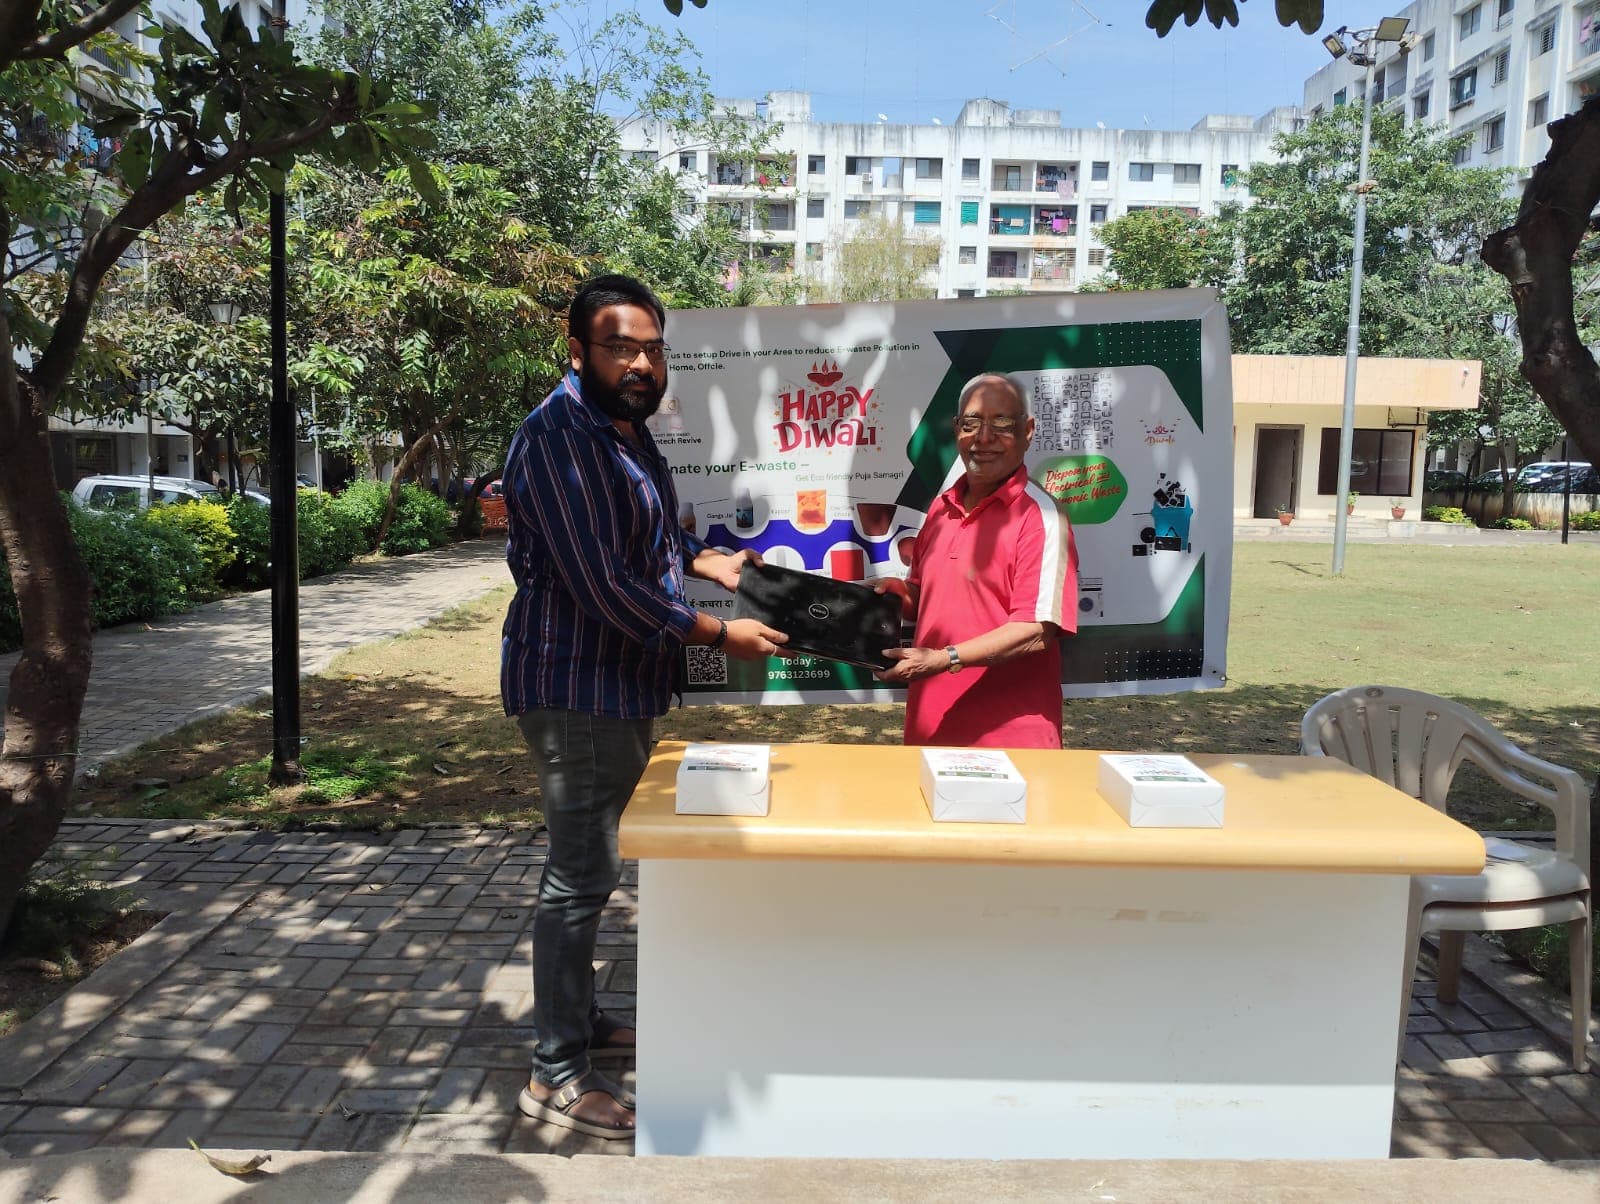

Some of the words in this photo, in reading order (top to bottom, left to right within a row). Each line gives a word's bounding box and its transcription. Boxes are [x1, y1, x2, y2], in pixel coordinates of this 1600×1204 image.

[694, 350, 718, 360] setup
[720, 350, 741, 358] Drive
[752, 349, 771, 358] your
[794, 347, 803, 355] to
[912, 342, 920, 351] in
[669, 364, 696, 372] Home,
[778, 386, 874, 422] HAPPY
[670, 464, 701, 474] nate
[705, 464, 736, 476] your
[740, 460, 797, 472] E-waste
[855, 472, 871, 481] Puja
[780, 656, 812, 667] Today
[768, 670, 831, 680] 9763123699
